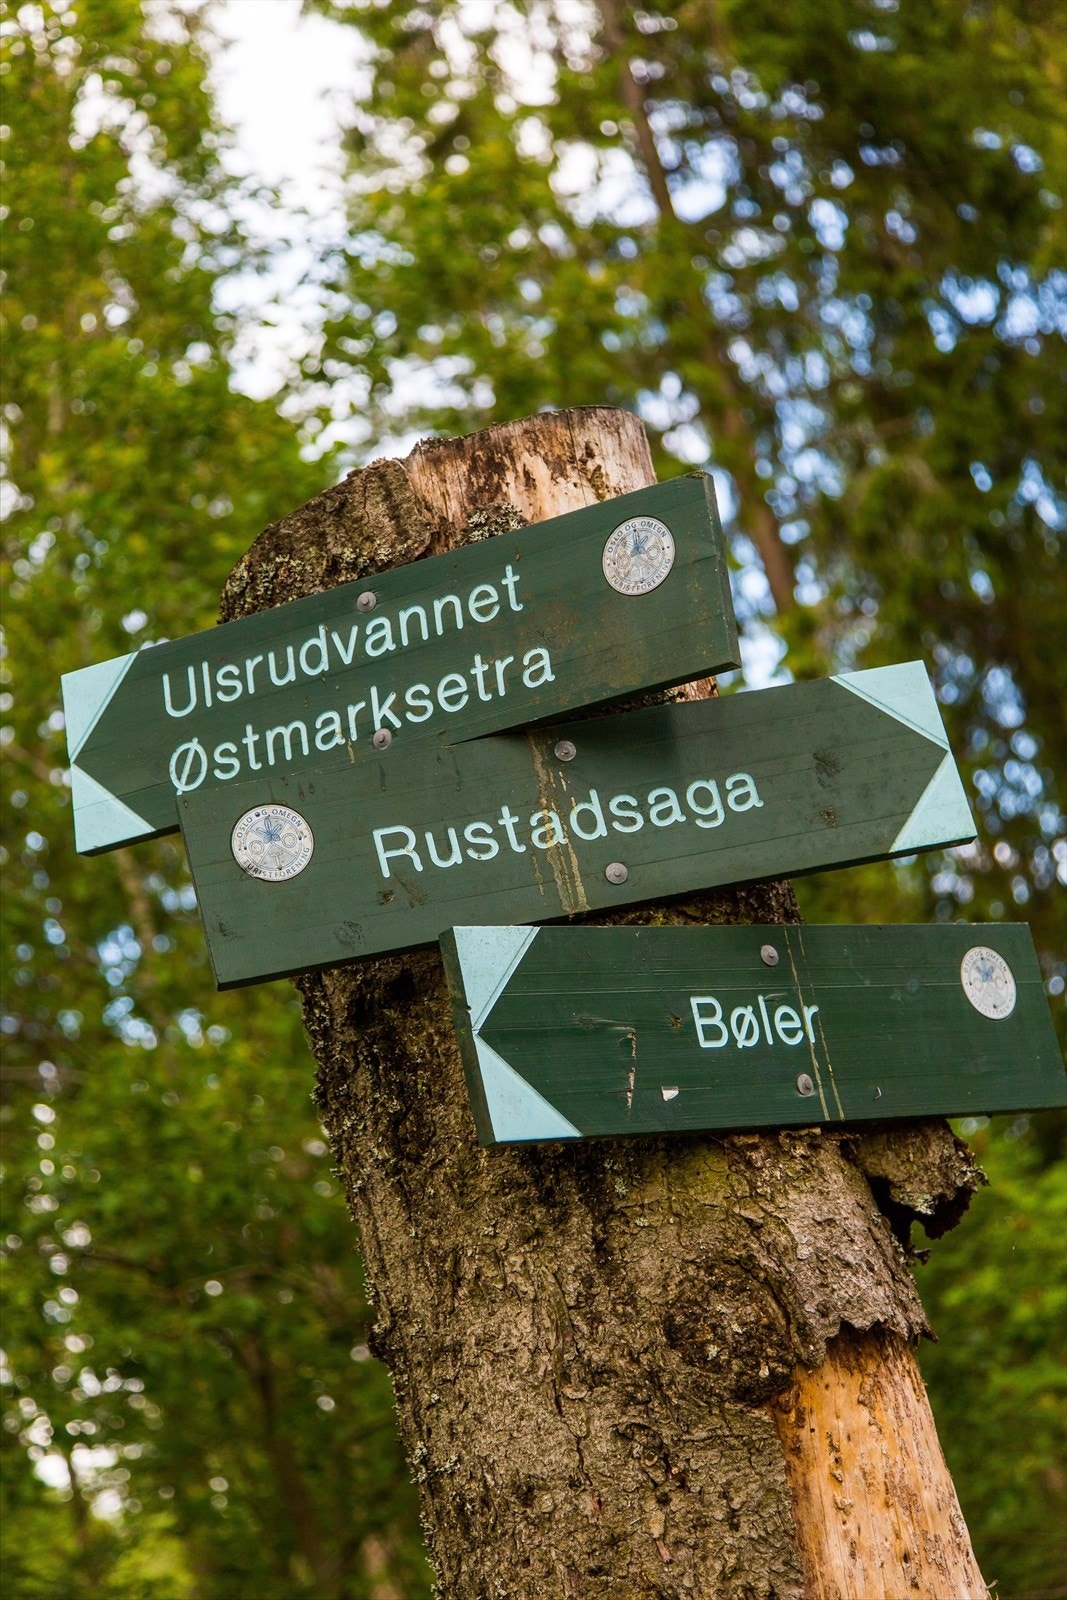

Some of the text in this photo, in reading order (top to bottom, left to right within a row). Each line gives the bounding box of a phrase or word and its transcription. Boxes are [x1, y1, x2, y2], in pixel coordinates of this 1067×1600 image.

[607, 520, 668, 553] OSLO OG OMEGN
[610, 558, 671, 592] TURISTFORENING
[162, 564, 524, 718] Ulsrudvannet
[168, 647, 556, 796] Østmarksetra
[236, 816, 253, 838] OSLO
[271, 808, 303, 827] OMEGN
[372, 772, 766, 879] Rustadsaga
[243, 847, 310, 878] TURISTFORENING
[689, 995, 820, 1049] Bøler
